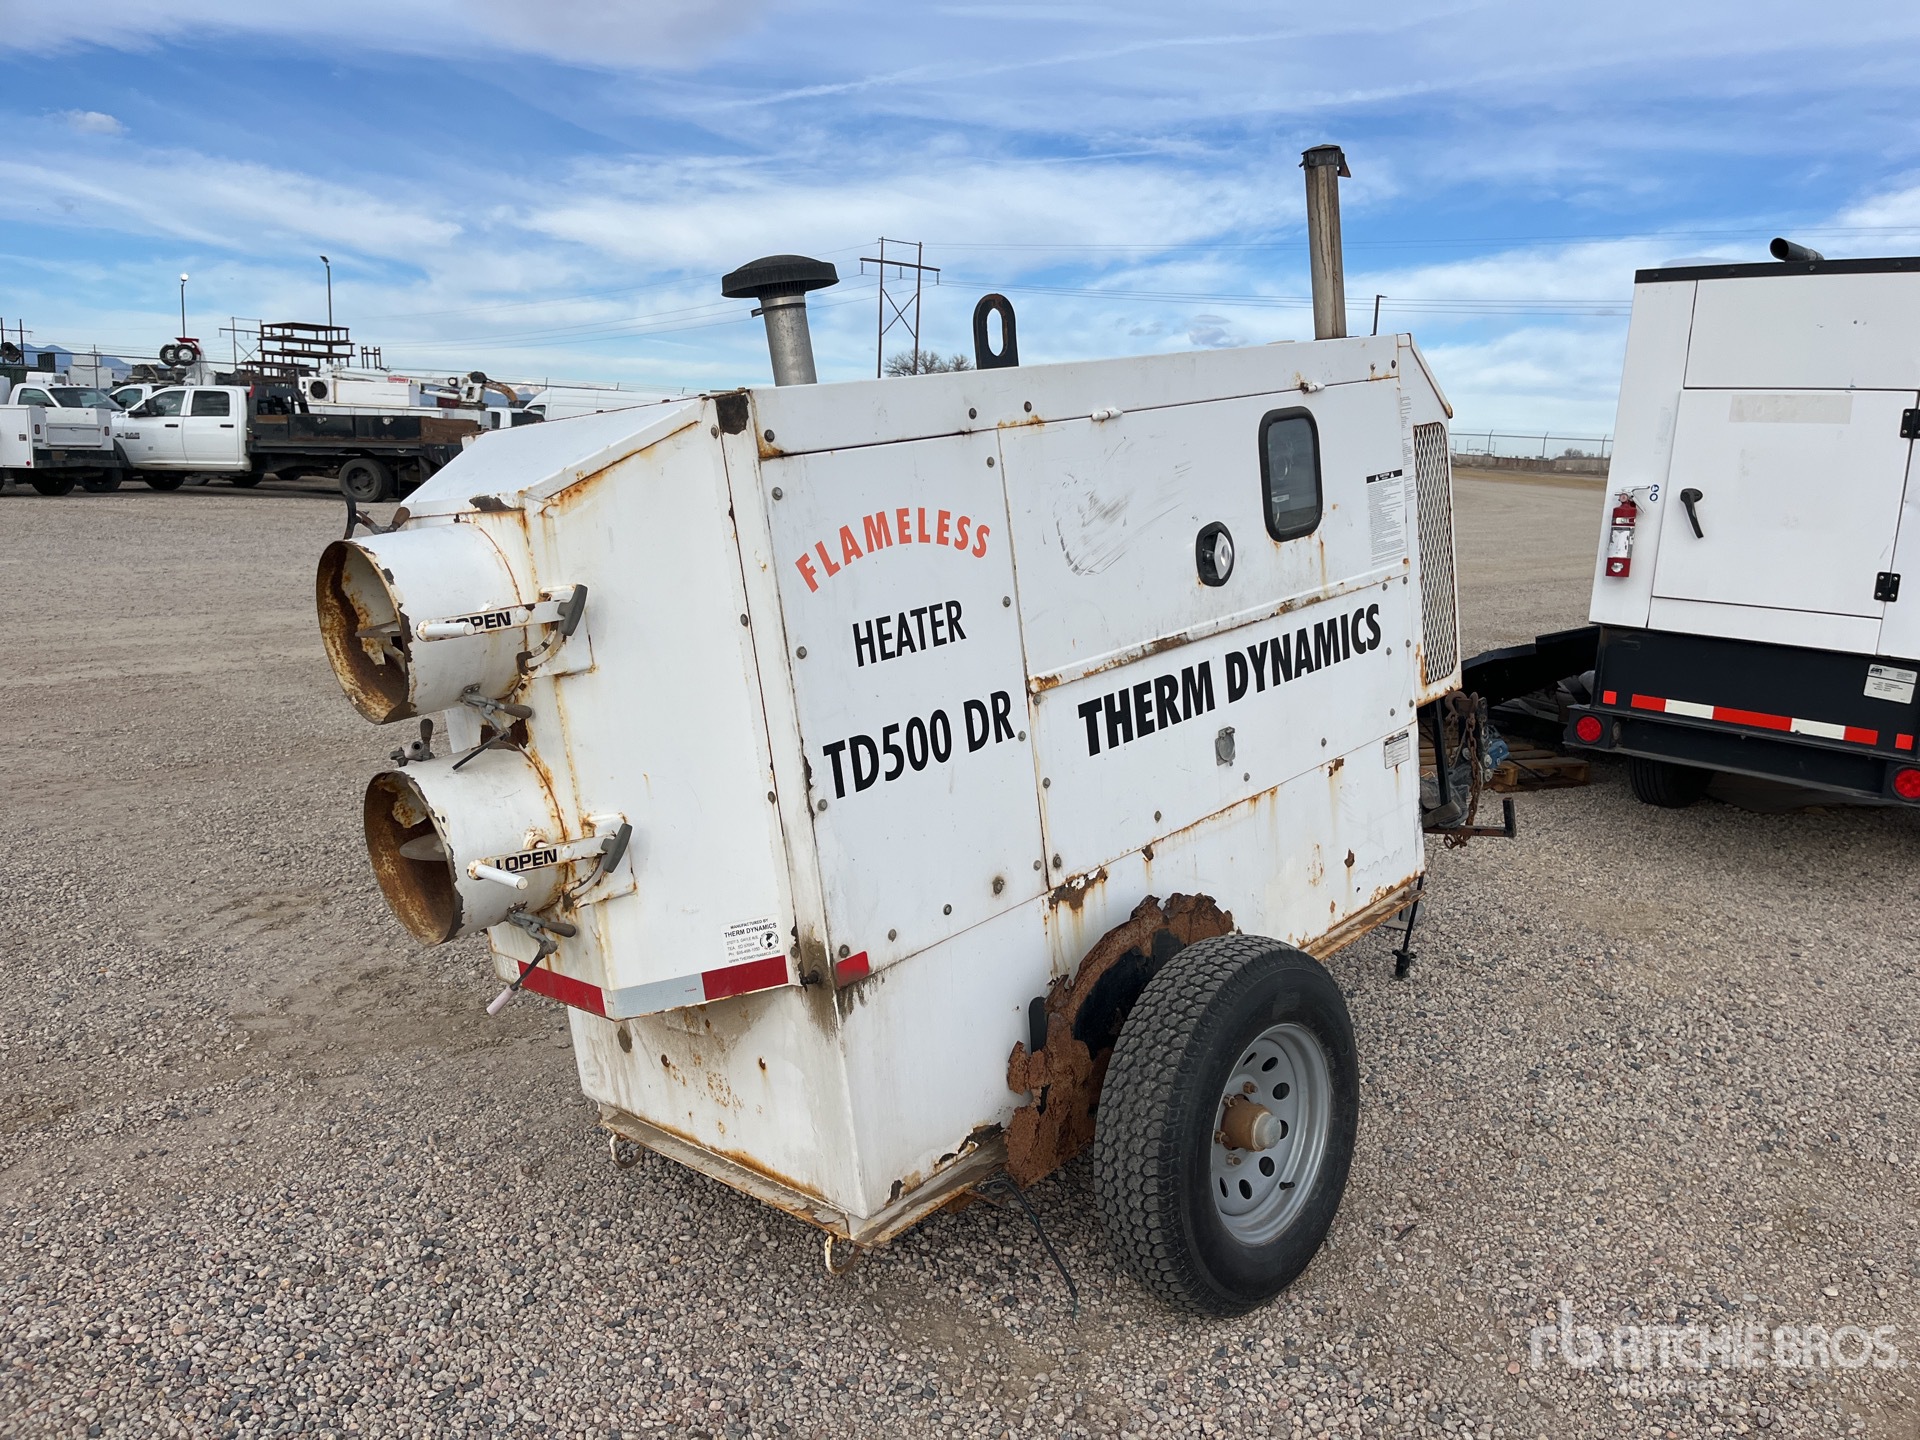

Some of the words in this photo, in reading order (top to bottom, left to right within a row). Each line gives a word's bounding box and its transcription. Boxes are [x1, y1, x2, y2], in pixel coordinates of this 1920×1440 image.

[795, 507, 990, 592] FLAMELESS
[852, 600, 967, 667] HEATER
[1077, 660, 1216, 757] THERM
[1225, 603, 1382, 704] DYNAMICS
[822, 709, 952, 800] TD500
[963, 690, 1016, 753] DR
[724, 928, 746, 938] THERM
[746, 922, 777, 934] DYNAMICS
[731, 919, 762, 929] MANUFACTURED
